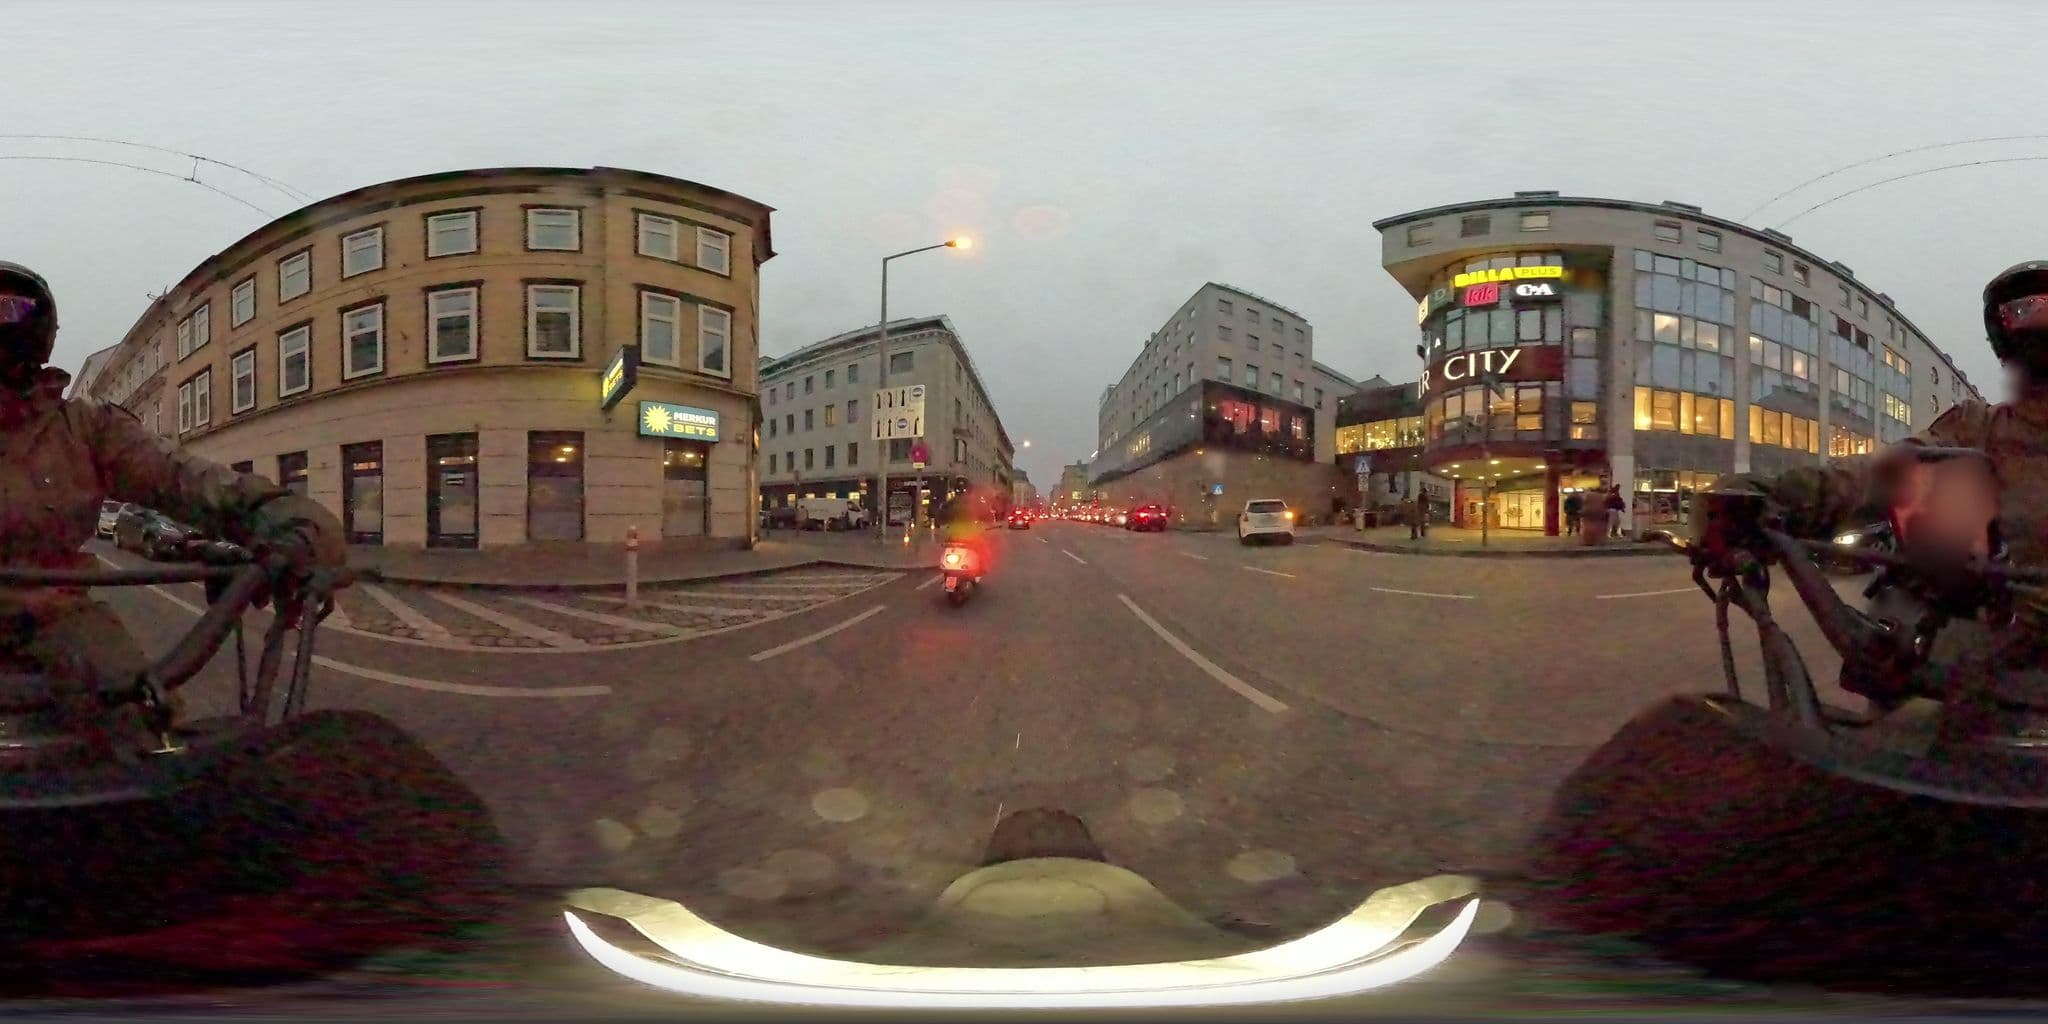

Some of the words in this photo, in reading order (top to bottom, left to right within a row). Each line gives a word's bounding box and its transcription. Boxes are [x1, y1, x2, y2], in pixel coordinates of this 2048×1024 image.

[1455, 268, 1514, 287] BILLA
[1521, 267, 1557, 276] PLUS
[1444, 349, 1522, 380] CITY
[673, 412, 716, 426] MERKUR
[673, 425, 716, 437] BETS
